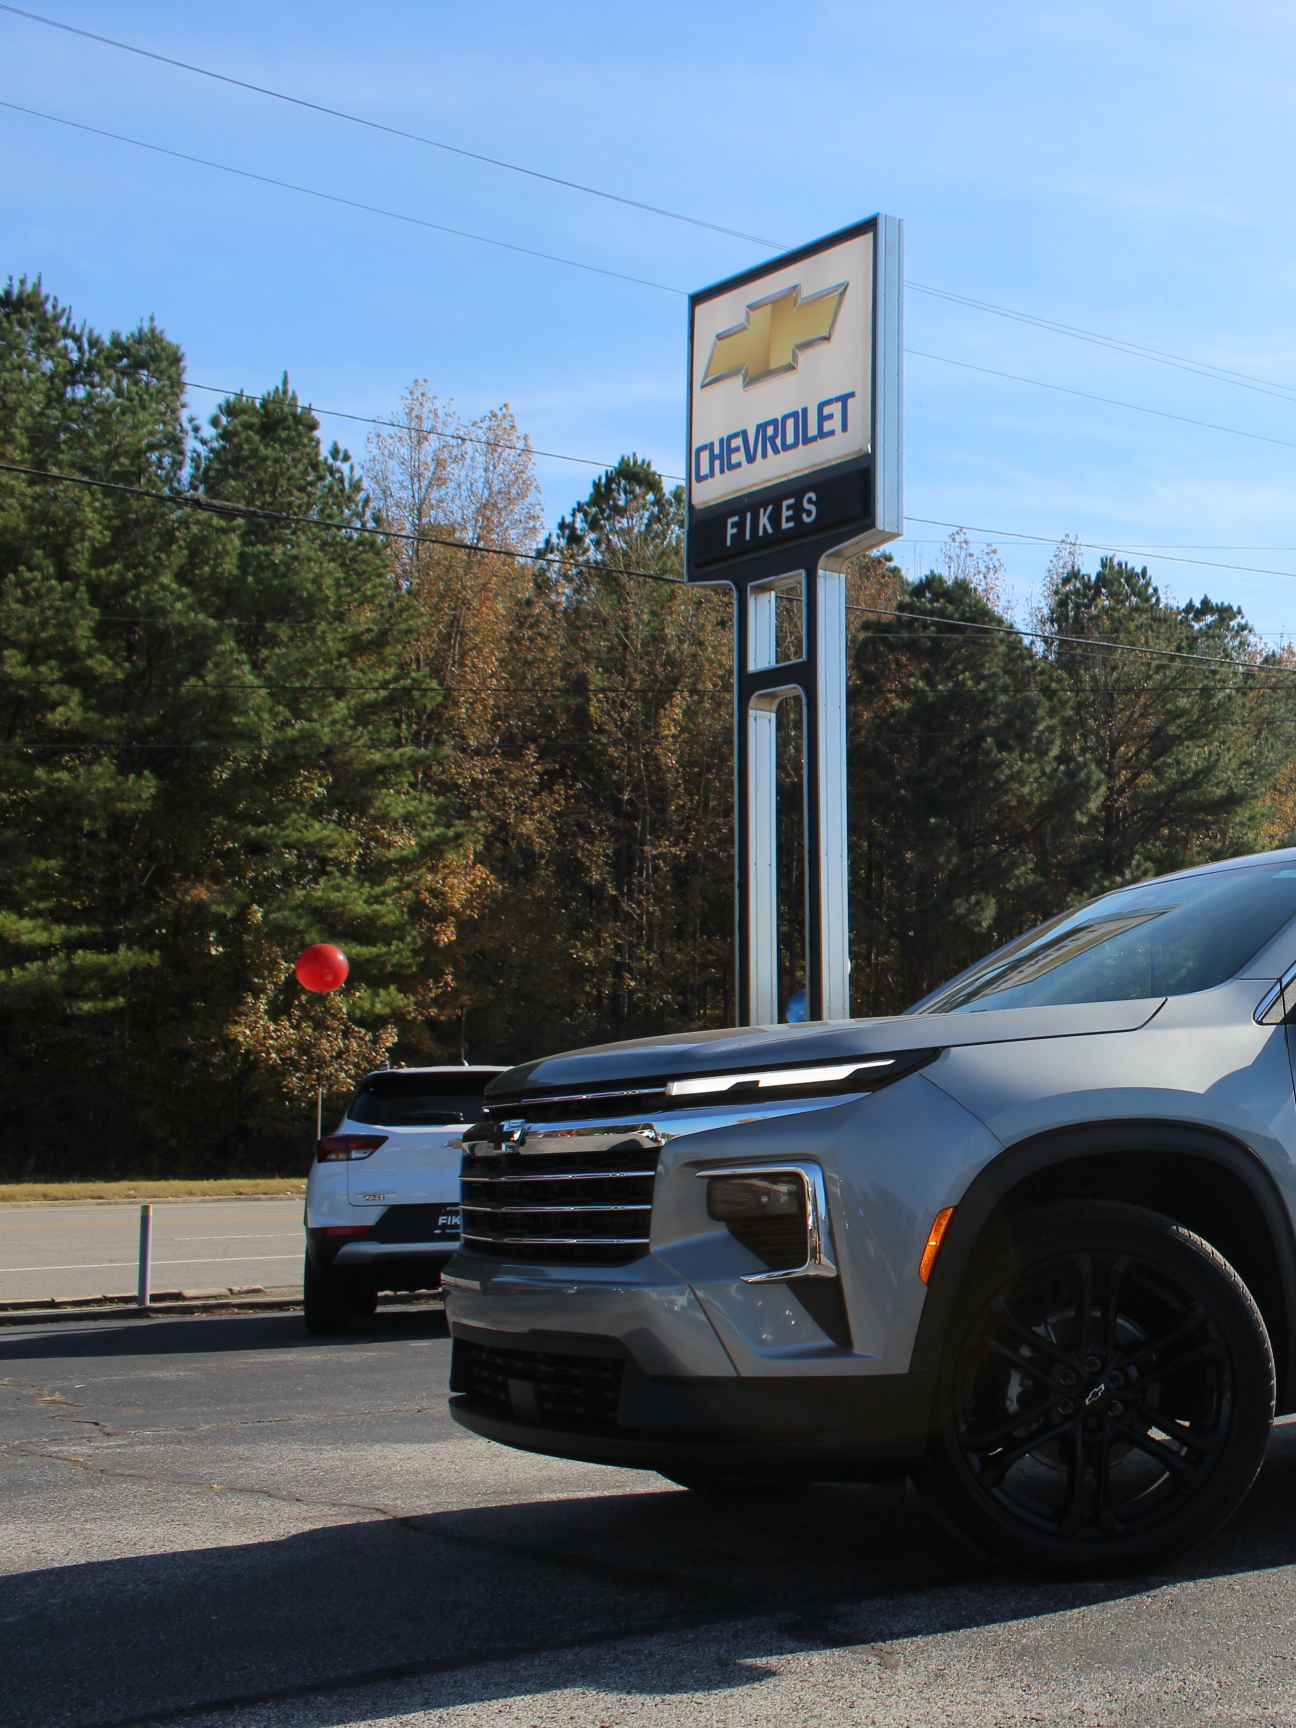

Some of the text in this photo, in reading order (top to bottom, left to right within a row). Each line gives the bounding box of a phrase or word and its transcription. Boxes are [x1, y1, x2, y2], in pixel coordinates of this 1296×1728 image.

[695, 391, 856, 483] CHEVROLET
[726, 491, 818, 547] FIKES
[438, 1215, 461, 1225] FIK
